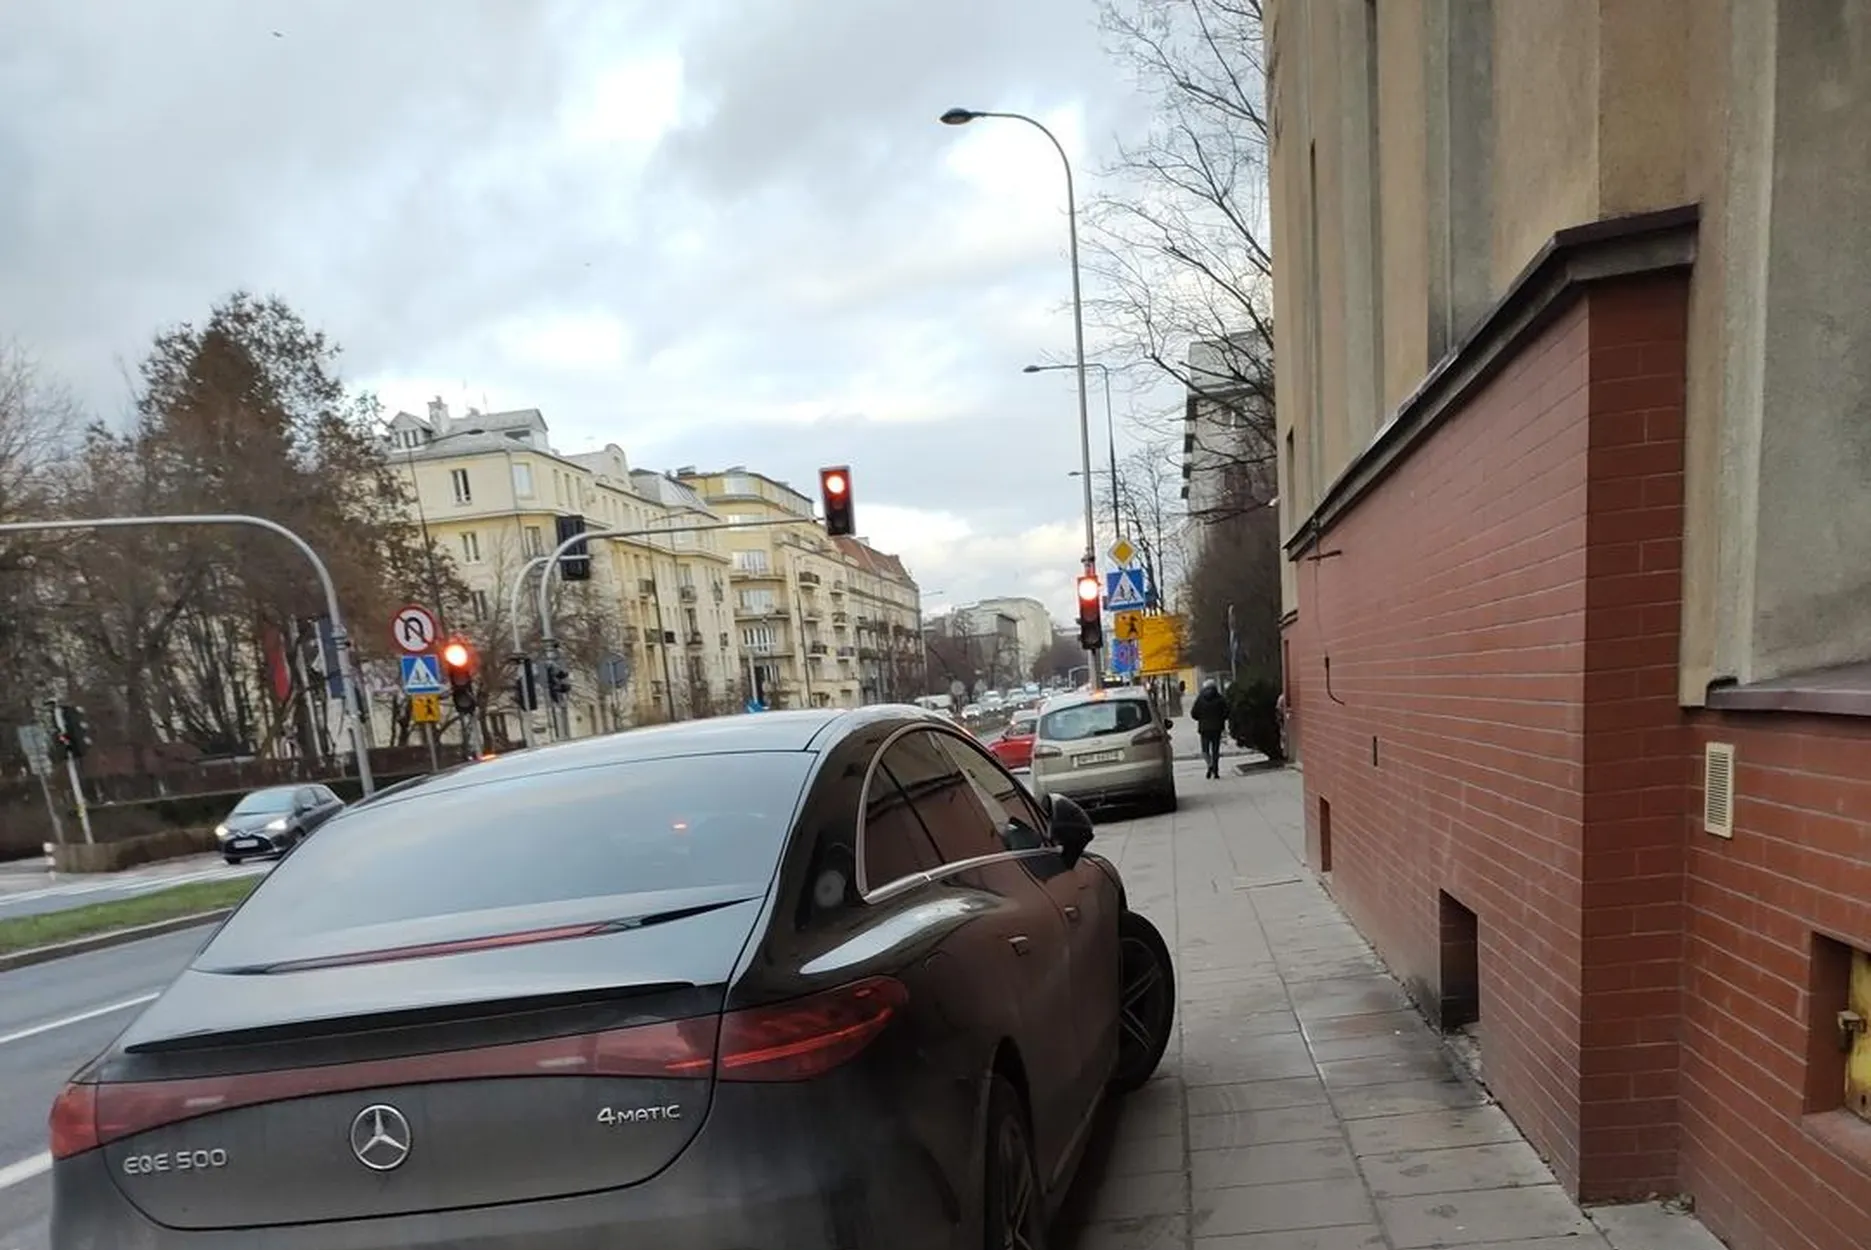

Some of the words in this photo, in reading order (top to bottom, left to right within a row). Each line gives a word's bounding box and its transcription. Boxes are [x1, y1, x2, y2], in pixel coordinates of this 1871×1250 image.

[597, 1105, 680, 1125] 4MATIC
[123, 1153, 170, 1174] EQE
[176, 1148, 227, 1169] 500
